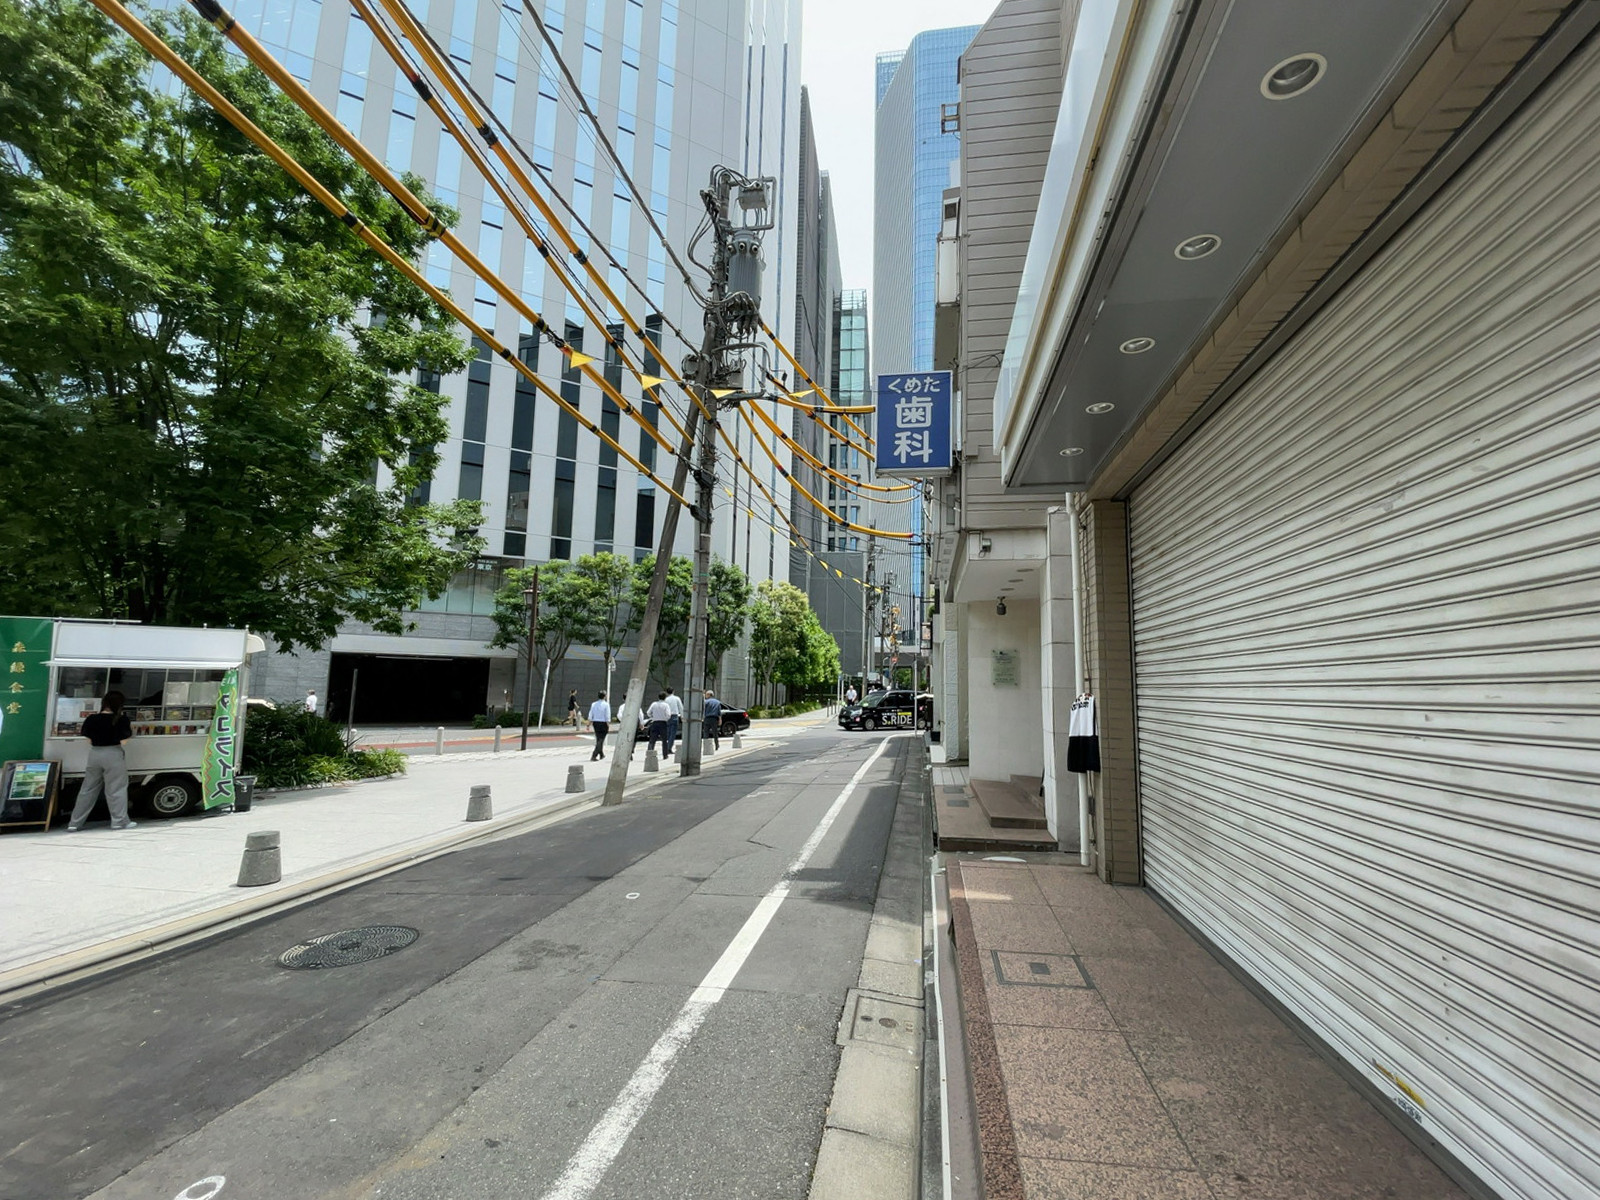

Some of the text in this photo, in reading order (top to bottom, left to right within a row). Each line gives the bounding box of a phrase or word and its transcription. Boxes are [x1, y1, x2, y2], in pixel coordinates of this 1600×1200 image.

[888, 376, 941, 394] くめた
[893, 396, 934, 464] 歯科
[882, 716, 913, 725] S.RIDE
[210, 693, 233, 800] タコライス
